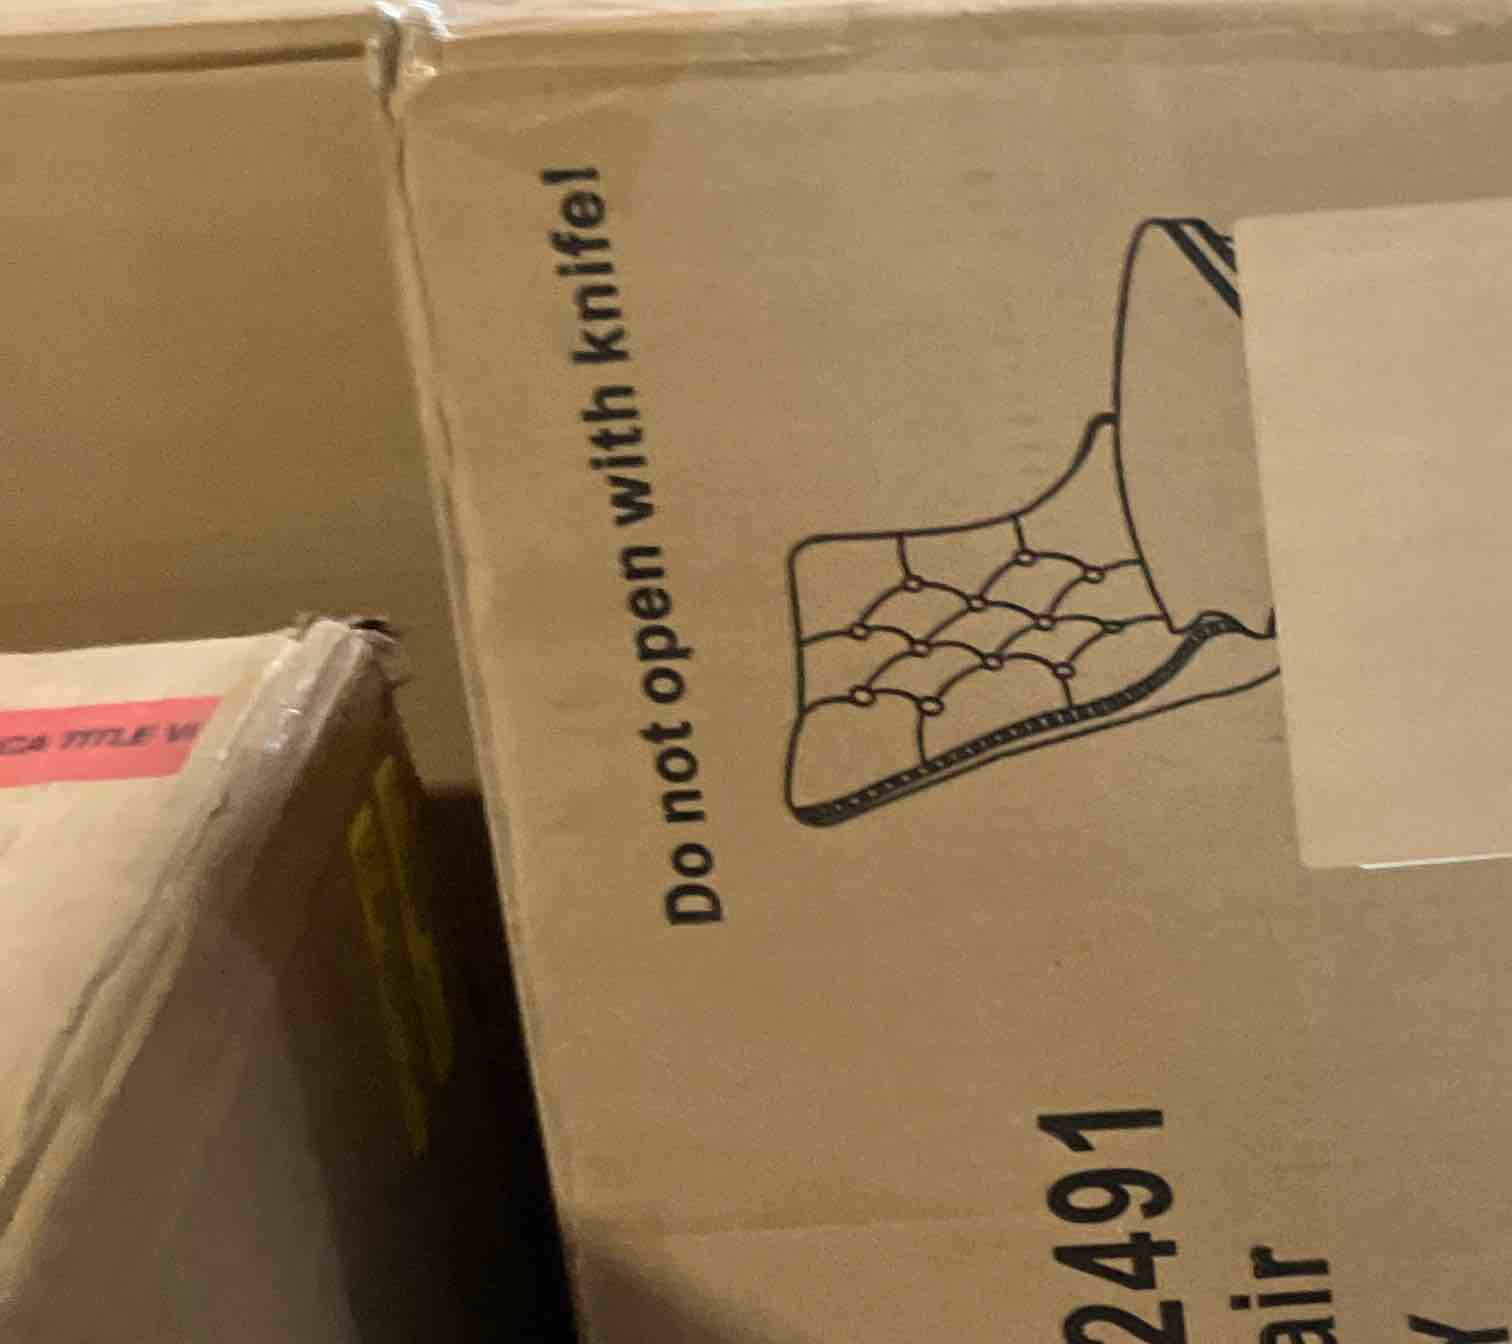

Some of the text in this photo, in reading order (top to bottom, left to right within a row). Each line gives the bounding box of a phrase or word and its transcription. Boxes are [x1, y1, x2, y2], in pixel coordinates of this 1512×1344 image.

[540, 165, 725, 927] Do not open with knife!
